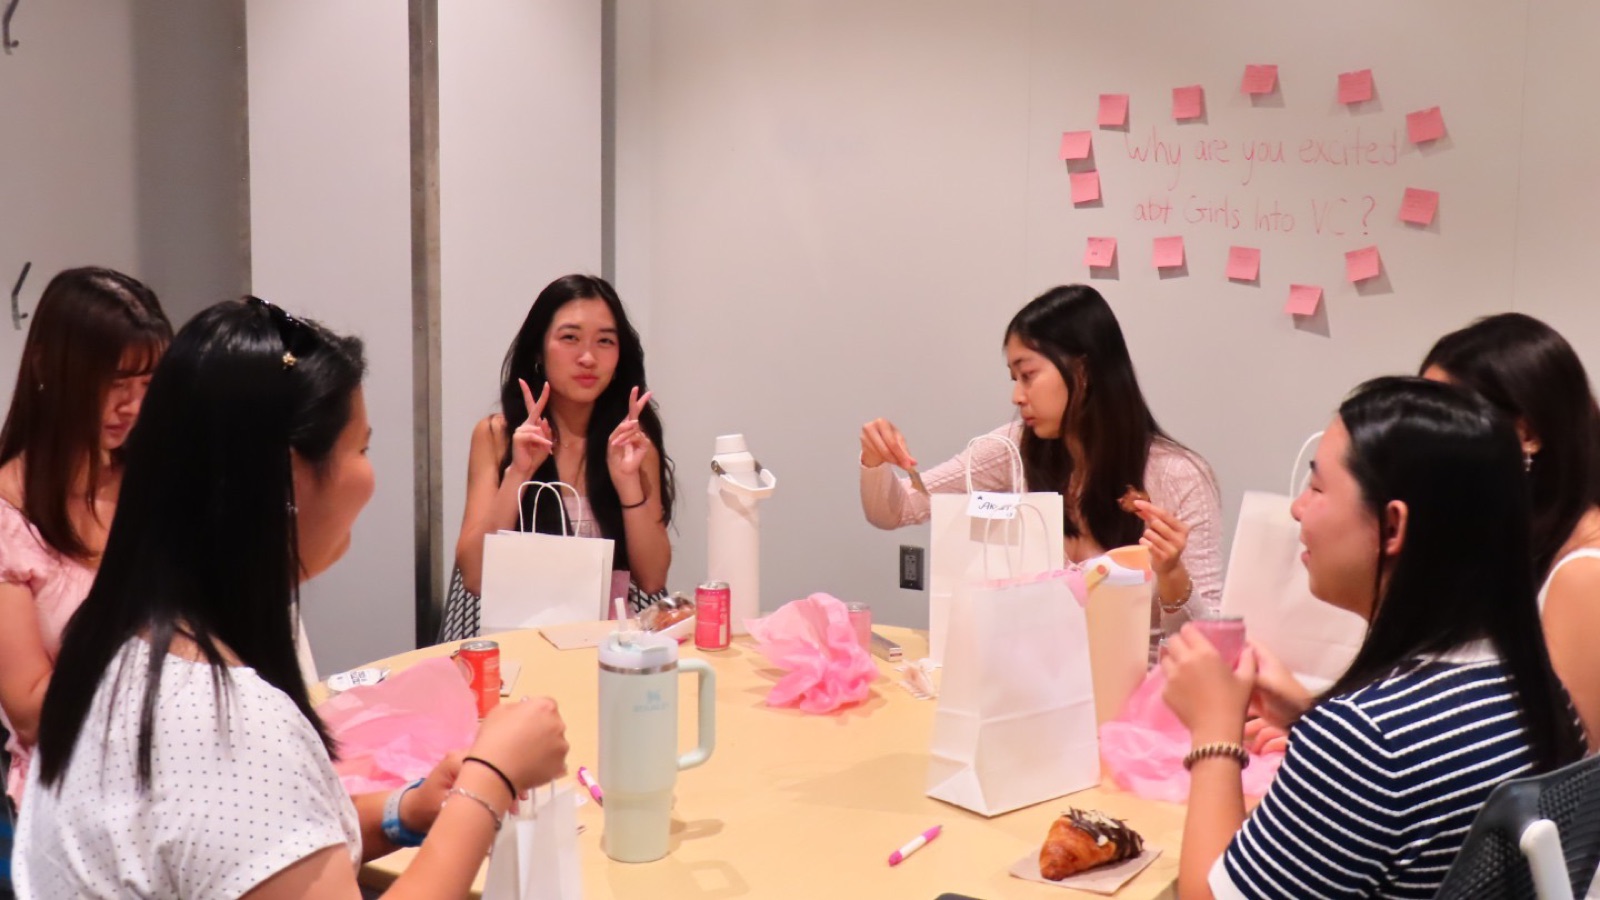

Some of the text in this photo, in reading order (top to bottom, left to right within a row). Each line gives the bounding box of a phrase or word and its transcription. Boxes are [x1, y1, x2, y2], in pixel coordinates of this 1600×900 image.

[1123, 124, 1182, 192] Why
[1194, 139, 1230, 163] are
[1241, 139, 1286, 187] you
[1298, 126, 1398, 167] excited
[1134, 197, 1174, 225] abt
[1183, 194, 1241, 230] Girls
